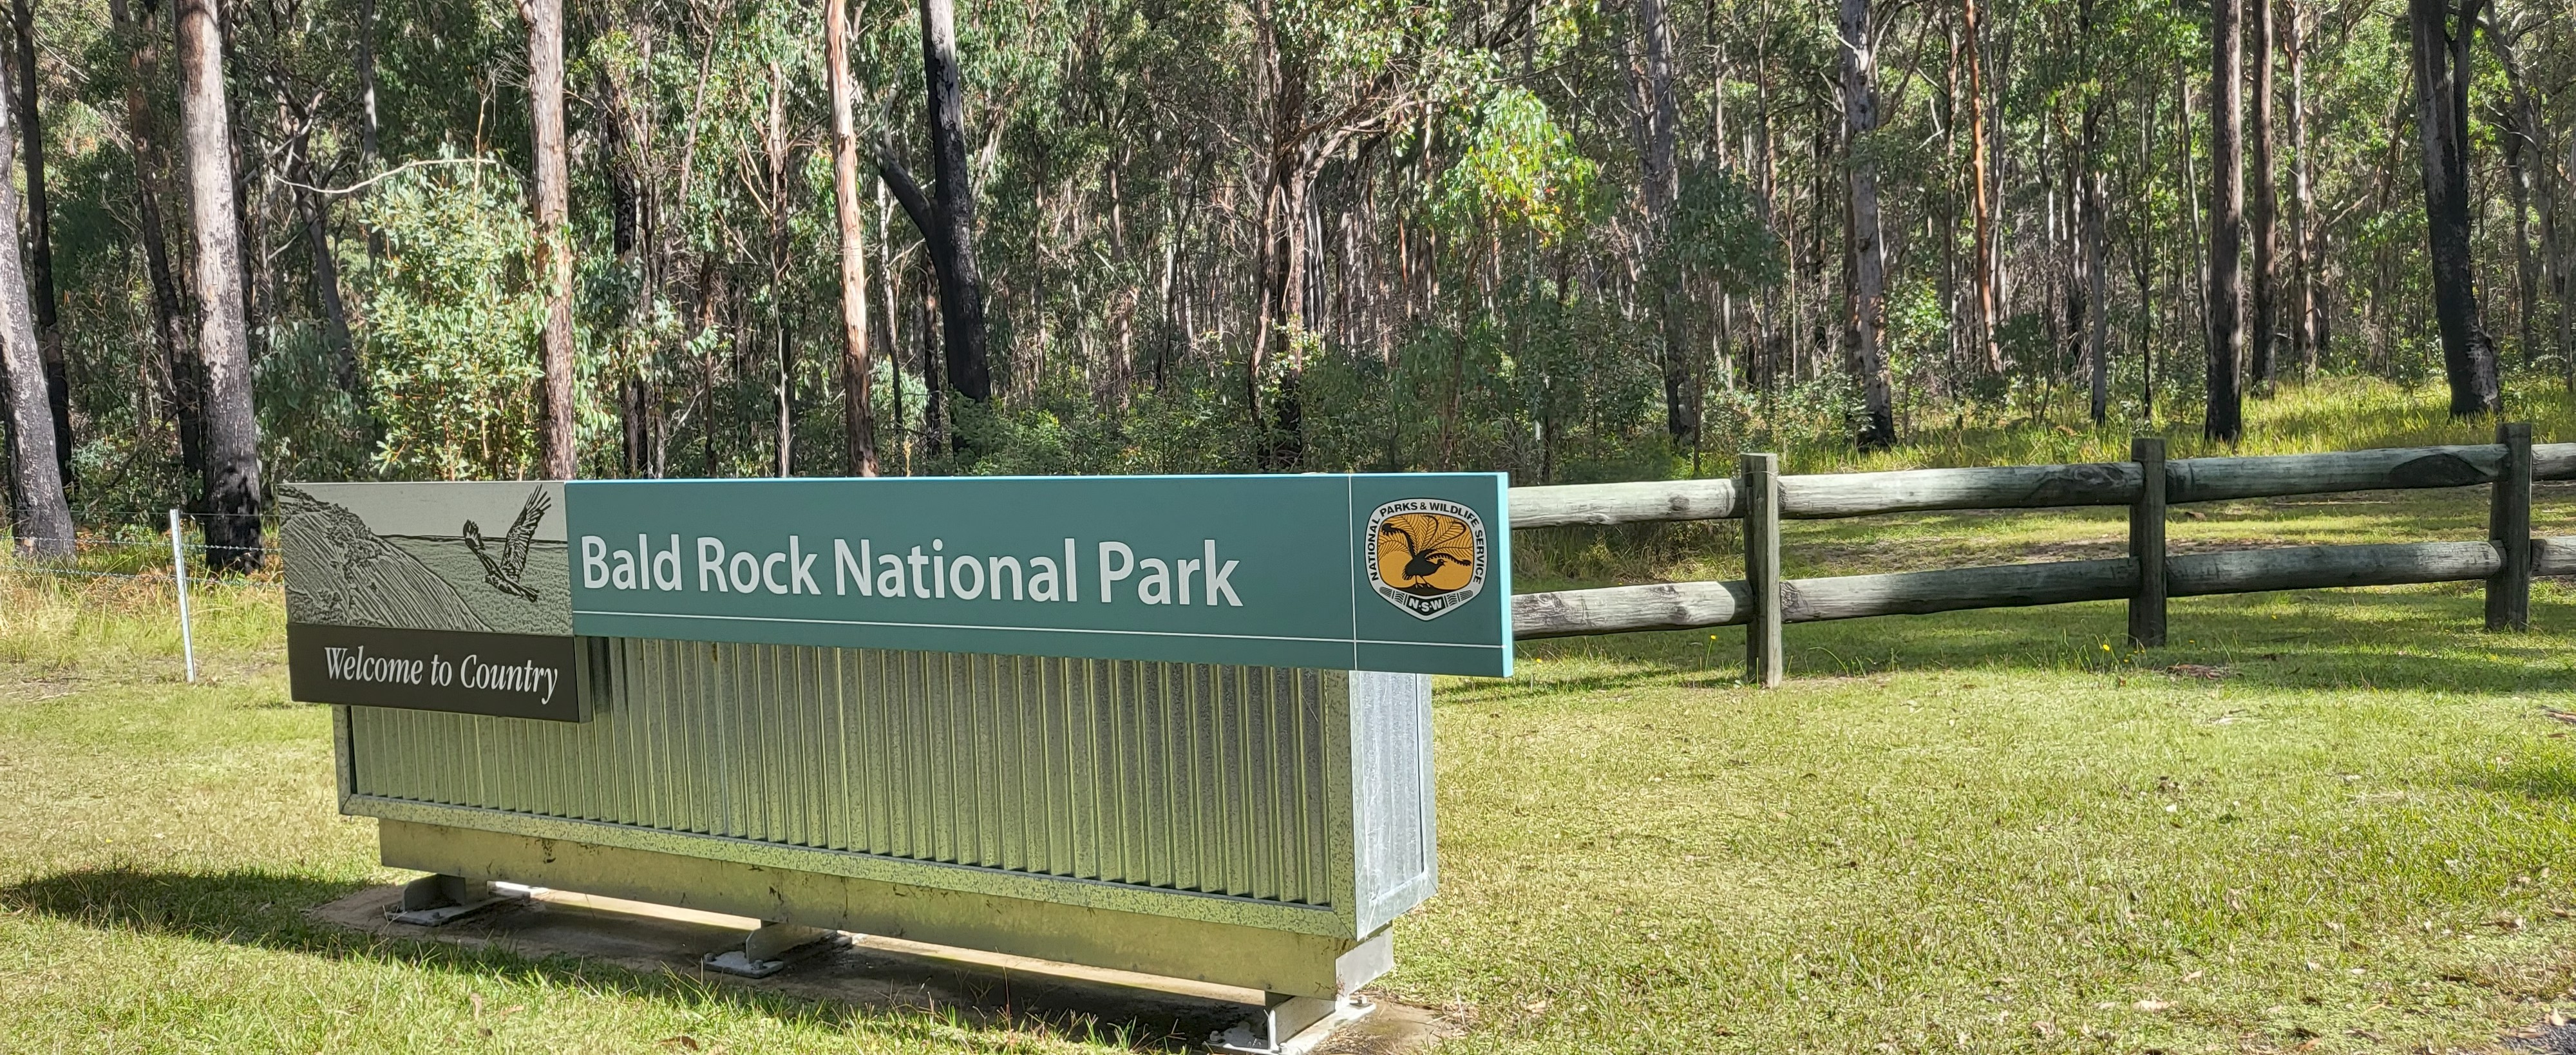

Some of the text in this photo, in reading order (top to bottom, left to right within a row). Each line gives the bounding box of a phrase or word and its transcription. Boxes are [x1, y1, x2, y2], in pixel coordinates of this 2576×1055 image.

[581, 533, 1244, 607] Bald Rock National Park
[1367, 517, 1381, 581] NATIONAL
[1379, 502, 1417, 517] PARKS
[1429, 502, 1479, 528] WILDLIFE
[1473, 529, 1484, 584] SERVICE
[324, 645, 558, 705] Welcome to Country
